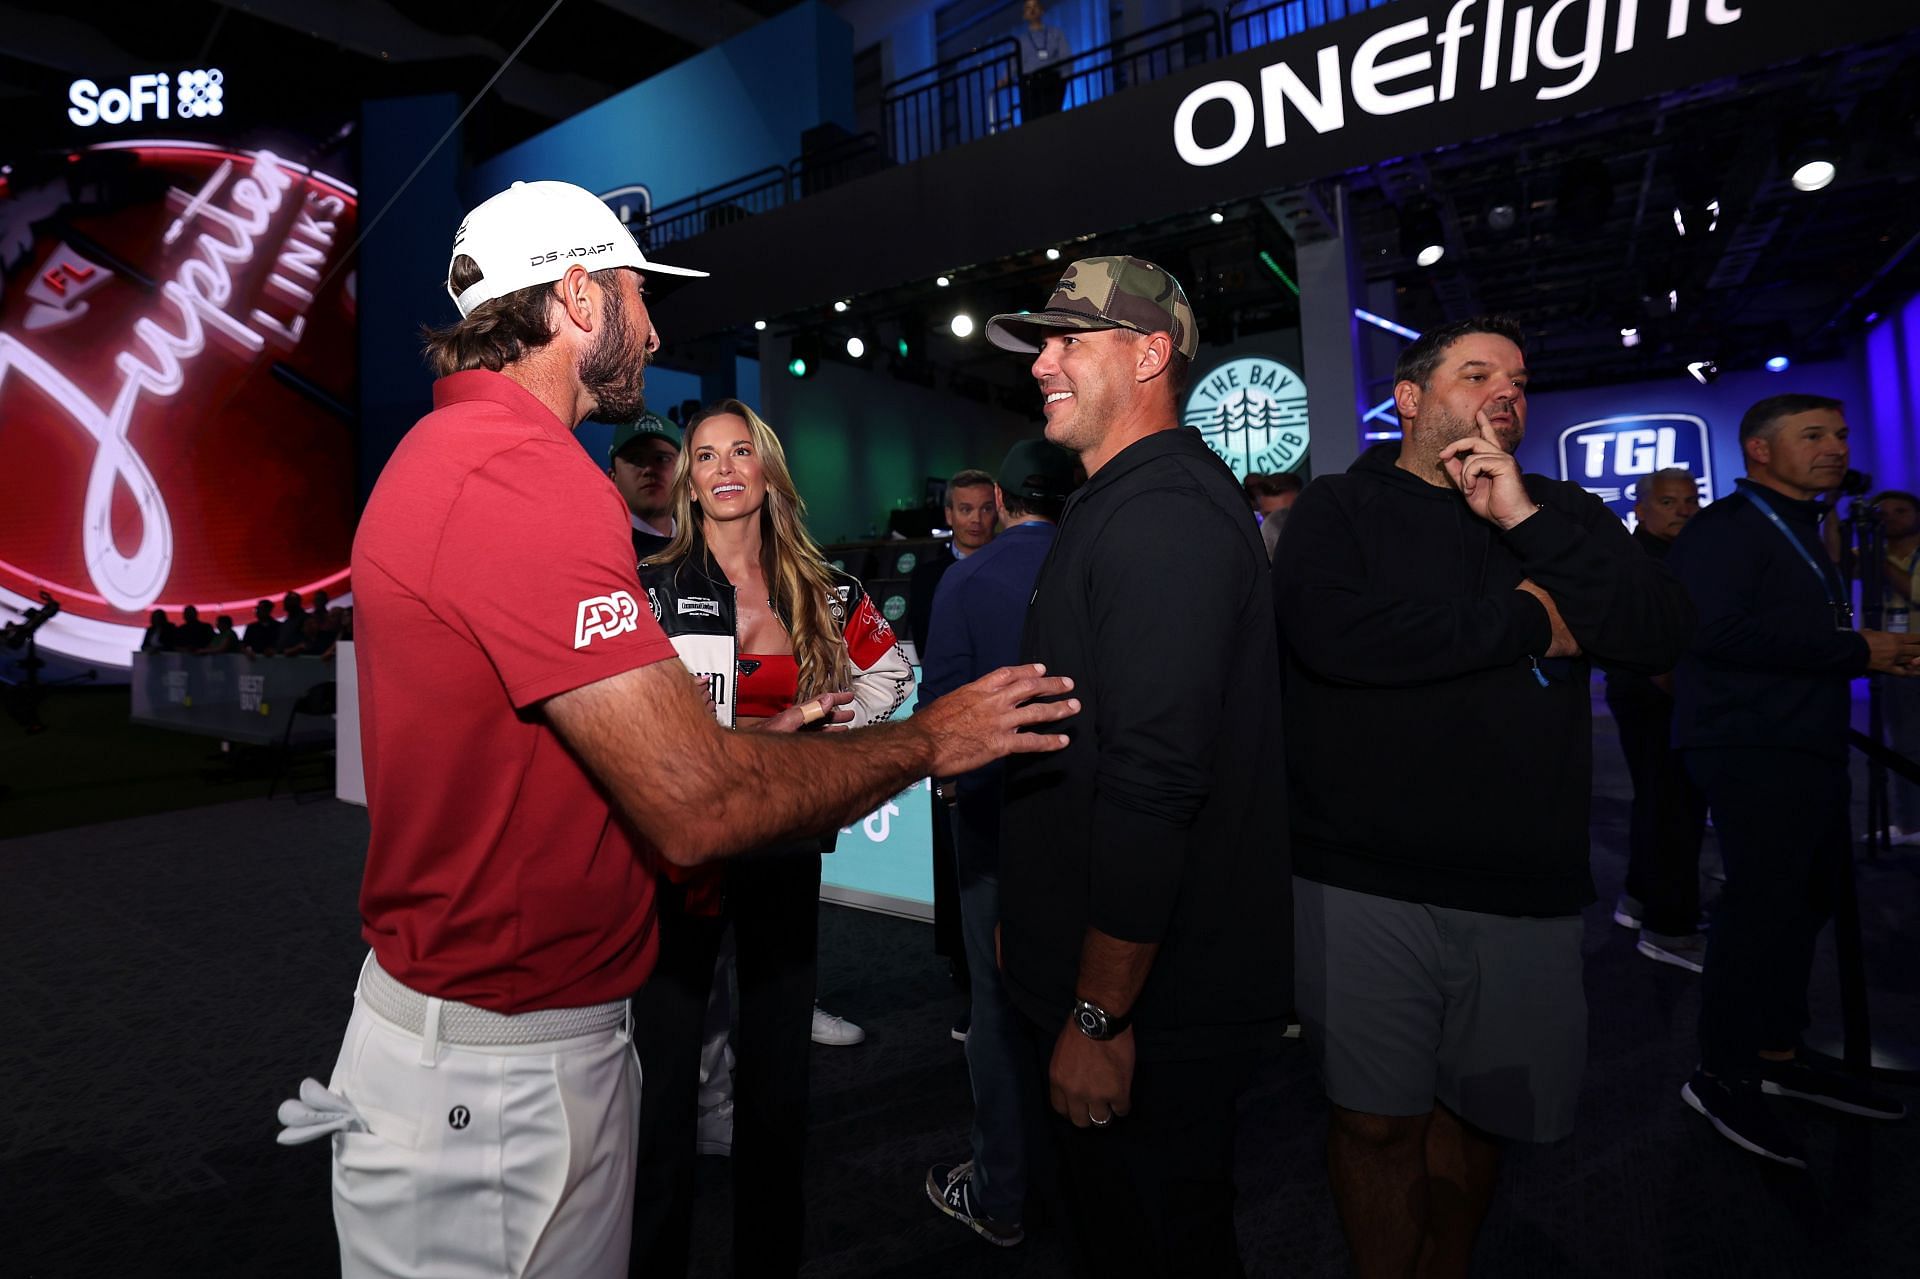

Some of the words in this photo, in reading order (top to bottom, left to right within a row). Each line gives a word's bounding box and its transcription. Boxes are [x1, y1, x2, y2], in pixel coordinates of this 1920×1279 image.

[67, 72, 170, 127] SoFi
[1174, 0, 1743, 166] ONEflig
[43, 261, 96, 297] FL
[250, 190, 346, 345] LINKS
[530, 242, 615, 267] DS-ADAPT
[1199, 367, 1241, 402] THE
[1249, 364, 1293, 394] BAY
[1256, 432, 1303, 475] CLUB
[1576, 426, 1690, 478] TGL
[574, 590, 639, 650] ADP
